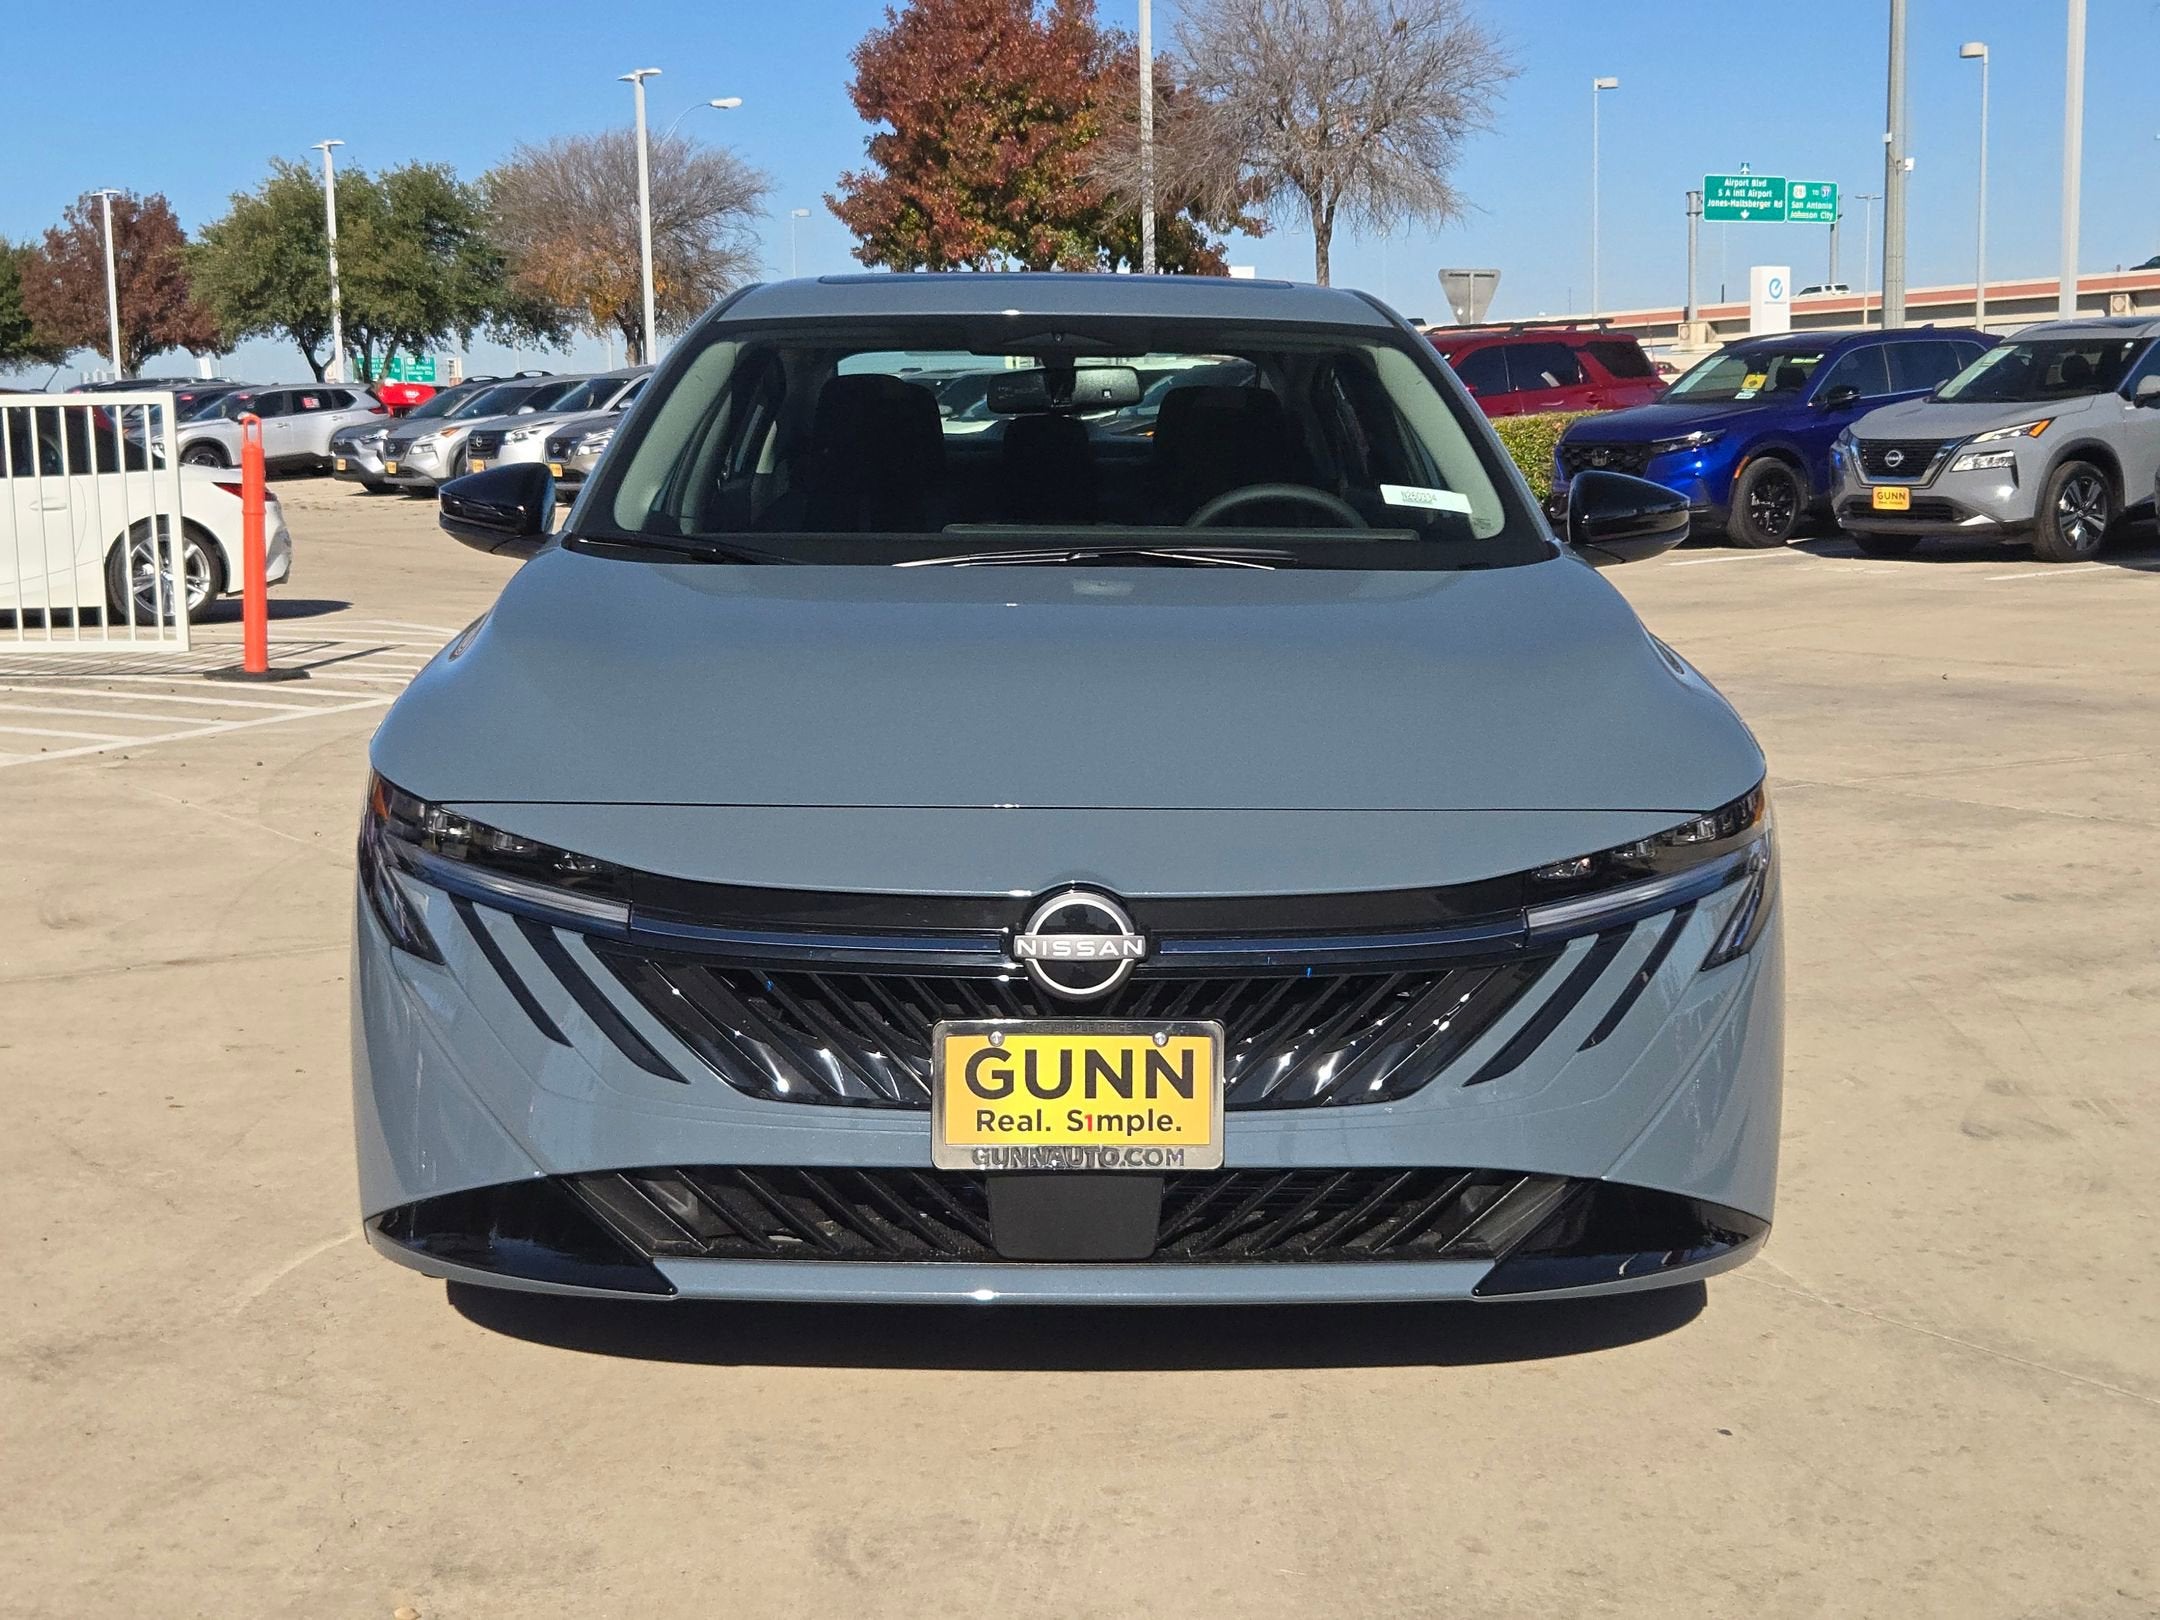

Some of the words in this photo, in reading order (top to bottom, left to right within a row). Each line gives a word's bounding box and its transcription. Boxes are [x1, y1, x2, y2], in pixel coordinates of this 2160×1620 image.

[1724, 178, 1749, 188] Airport
[1752, 179, 1767, 187] Blvd
[1747, 190, 1772, 199] Airport
[1773, 200, 1783, 208] Rd
[1791, 201, 1804, 209] San
[1806, 201, 1833, 209] Antonio
[1820, 211, 1833, 220] City
[1877, 490, 1906, 500] GUNN
[1017, 939, 1143, 956] NISSAN
[964, 1047, 1194, 1099] GUNN
[976, 1109, 1051, 1132] Real.
[971, 1145, 1185, 1168] GUNNAUTO.COM
